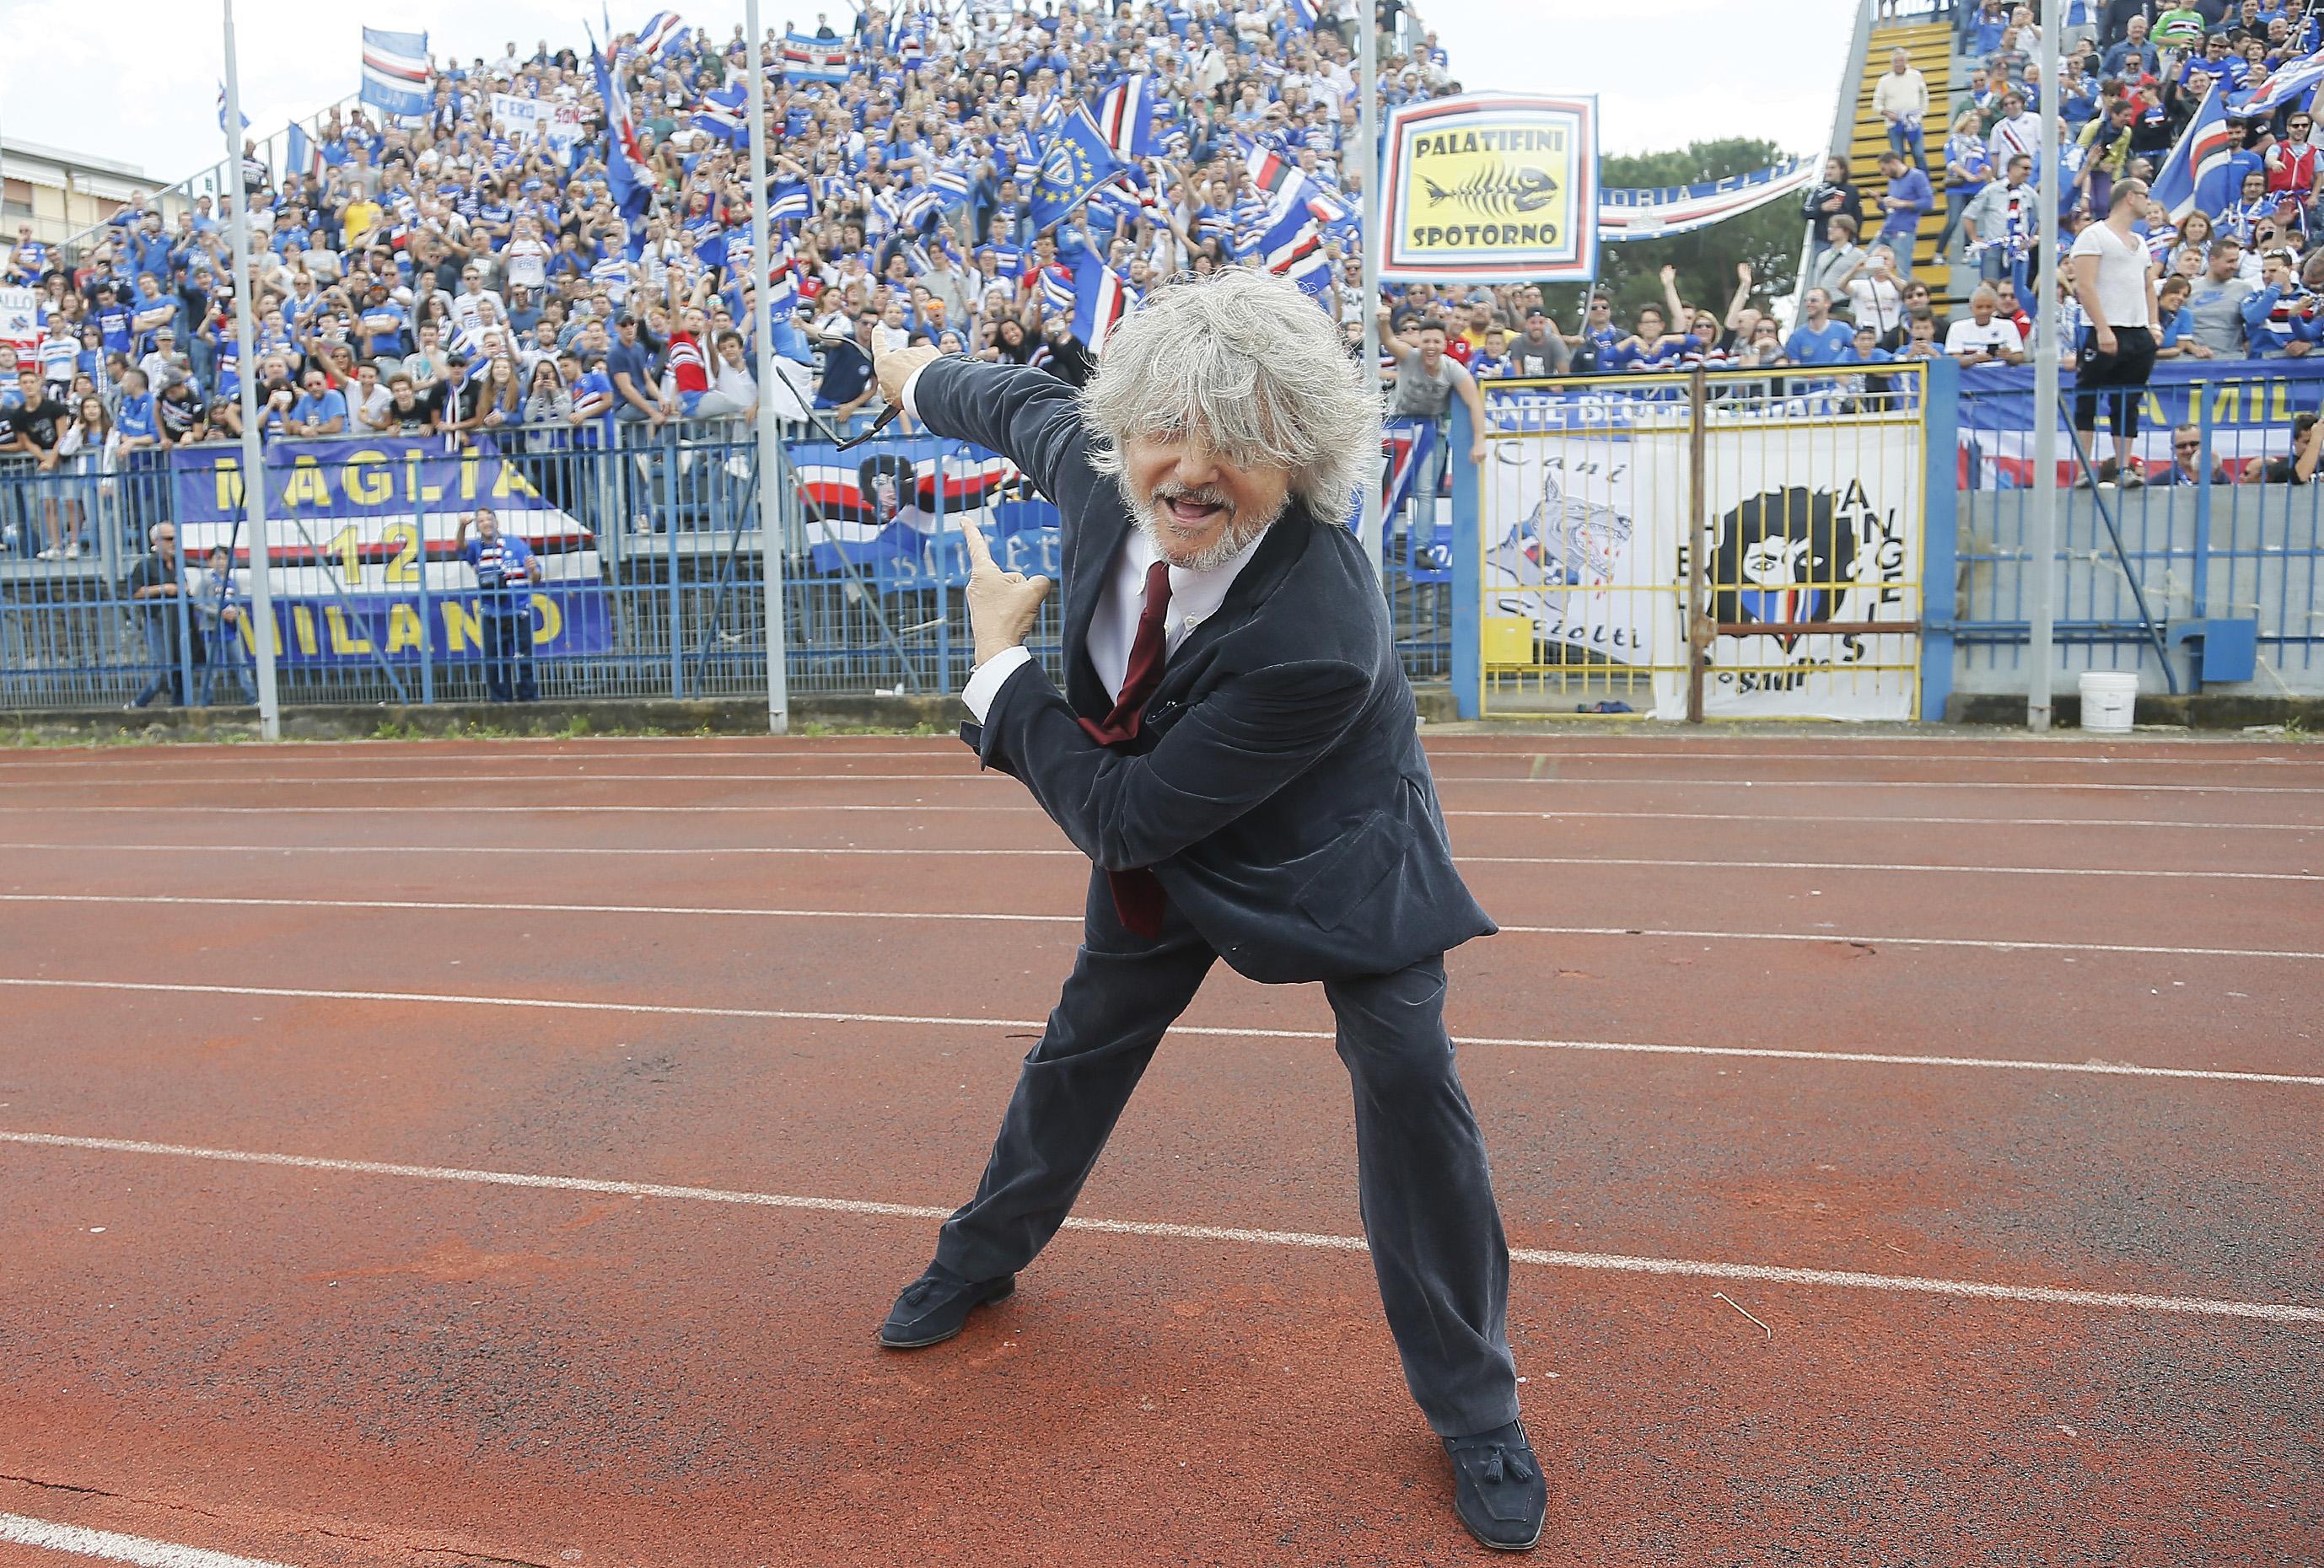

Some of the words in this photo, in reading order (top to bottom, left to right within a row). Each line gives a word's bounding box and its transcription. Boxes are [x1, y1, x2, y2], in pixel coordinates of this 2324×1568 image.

[1416, 131, 1564, 158] PALATIFINI
[1413, 223, 1557, 247] SPOTORNO
[214, 445, 541, 511] MAGLIA
[1493, 439, 1627, 484] Cani
[325, 522, 421, 586] 12
